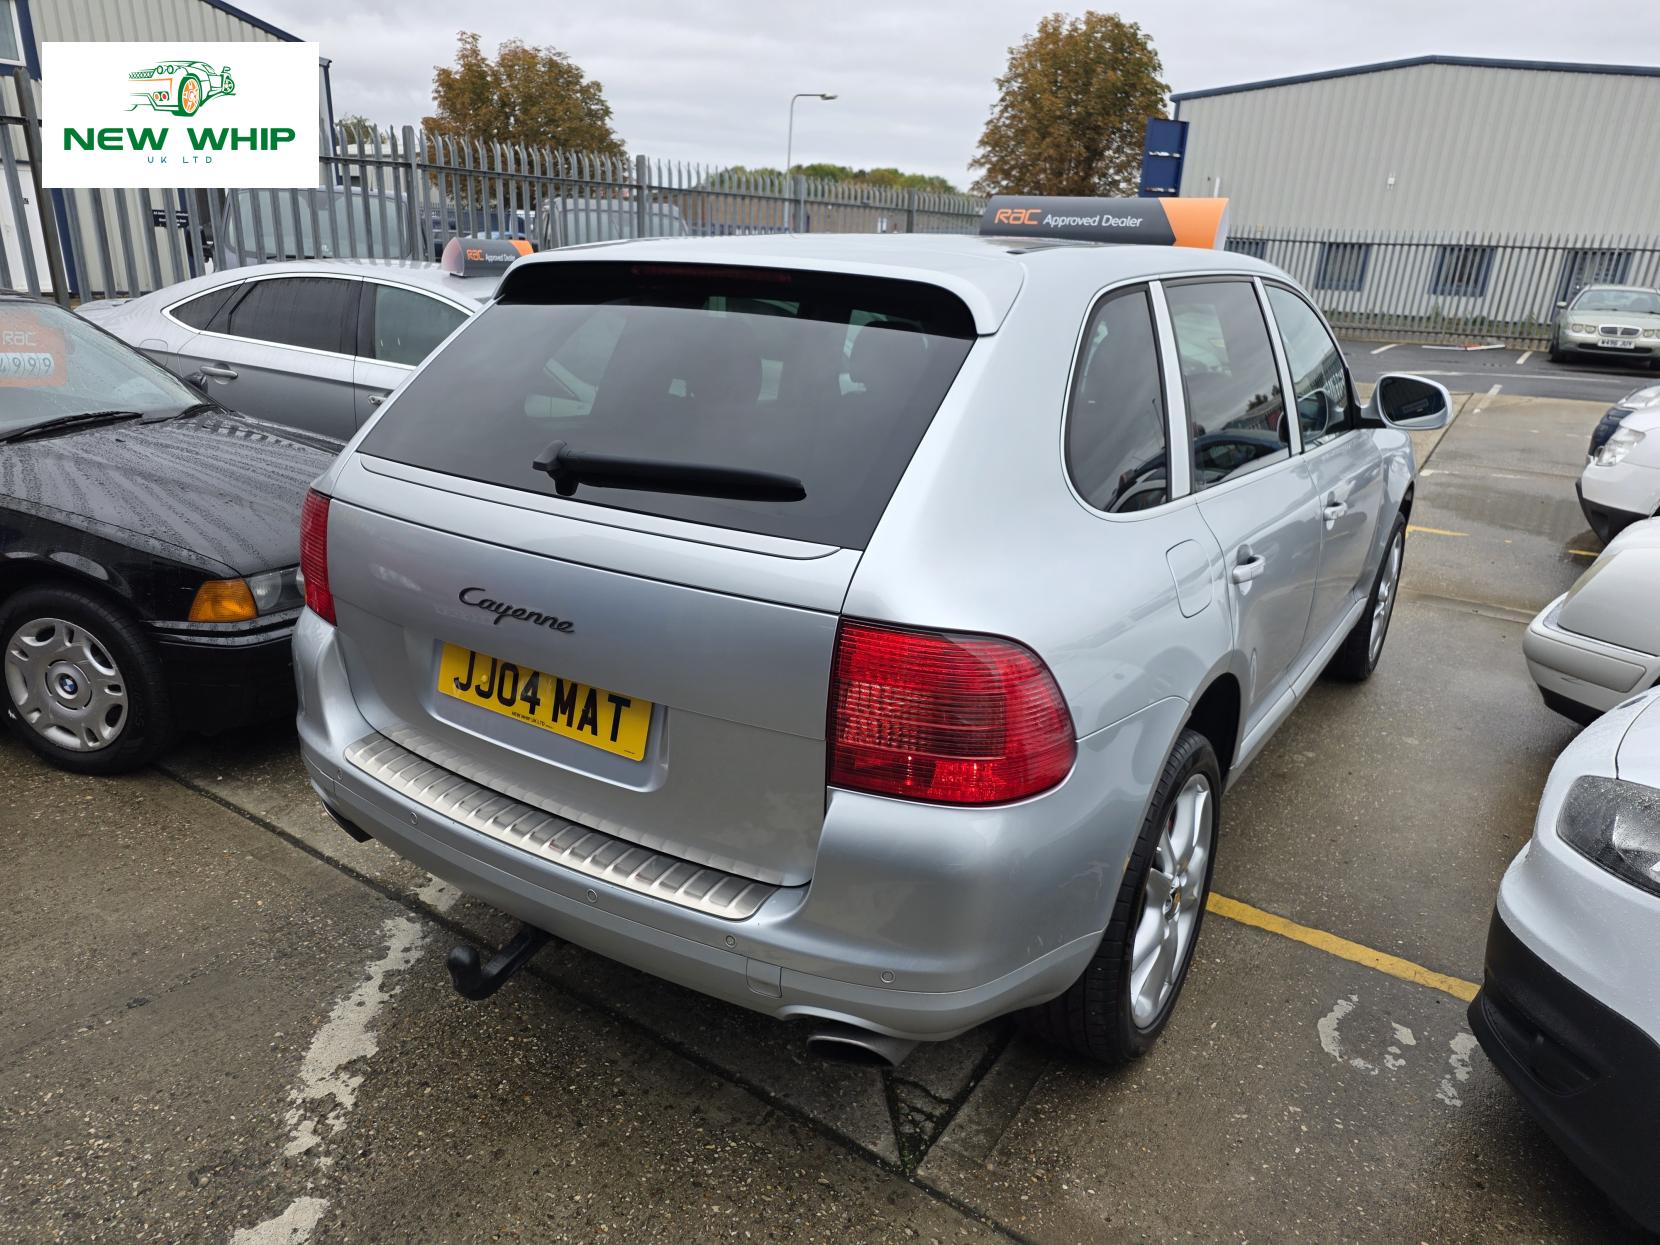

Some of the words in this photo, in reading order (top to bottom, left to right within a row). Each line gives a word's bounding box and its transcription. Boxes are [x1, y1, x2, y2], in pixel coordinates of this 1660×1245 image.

[1043, 214, 1100, 228] Approved
[1102, 214, 1143, 227] Dealer
[458, 586, 575, 634] Cayenne
[453, 650, 541, 715] JJ04
[551, 678, 631, 743] MAT
